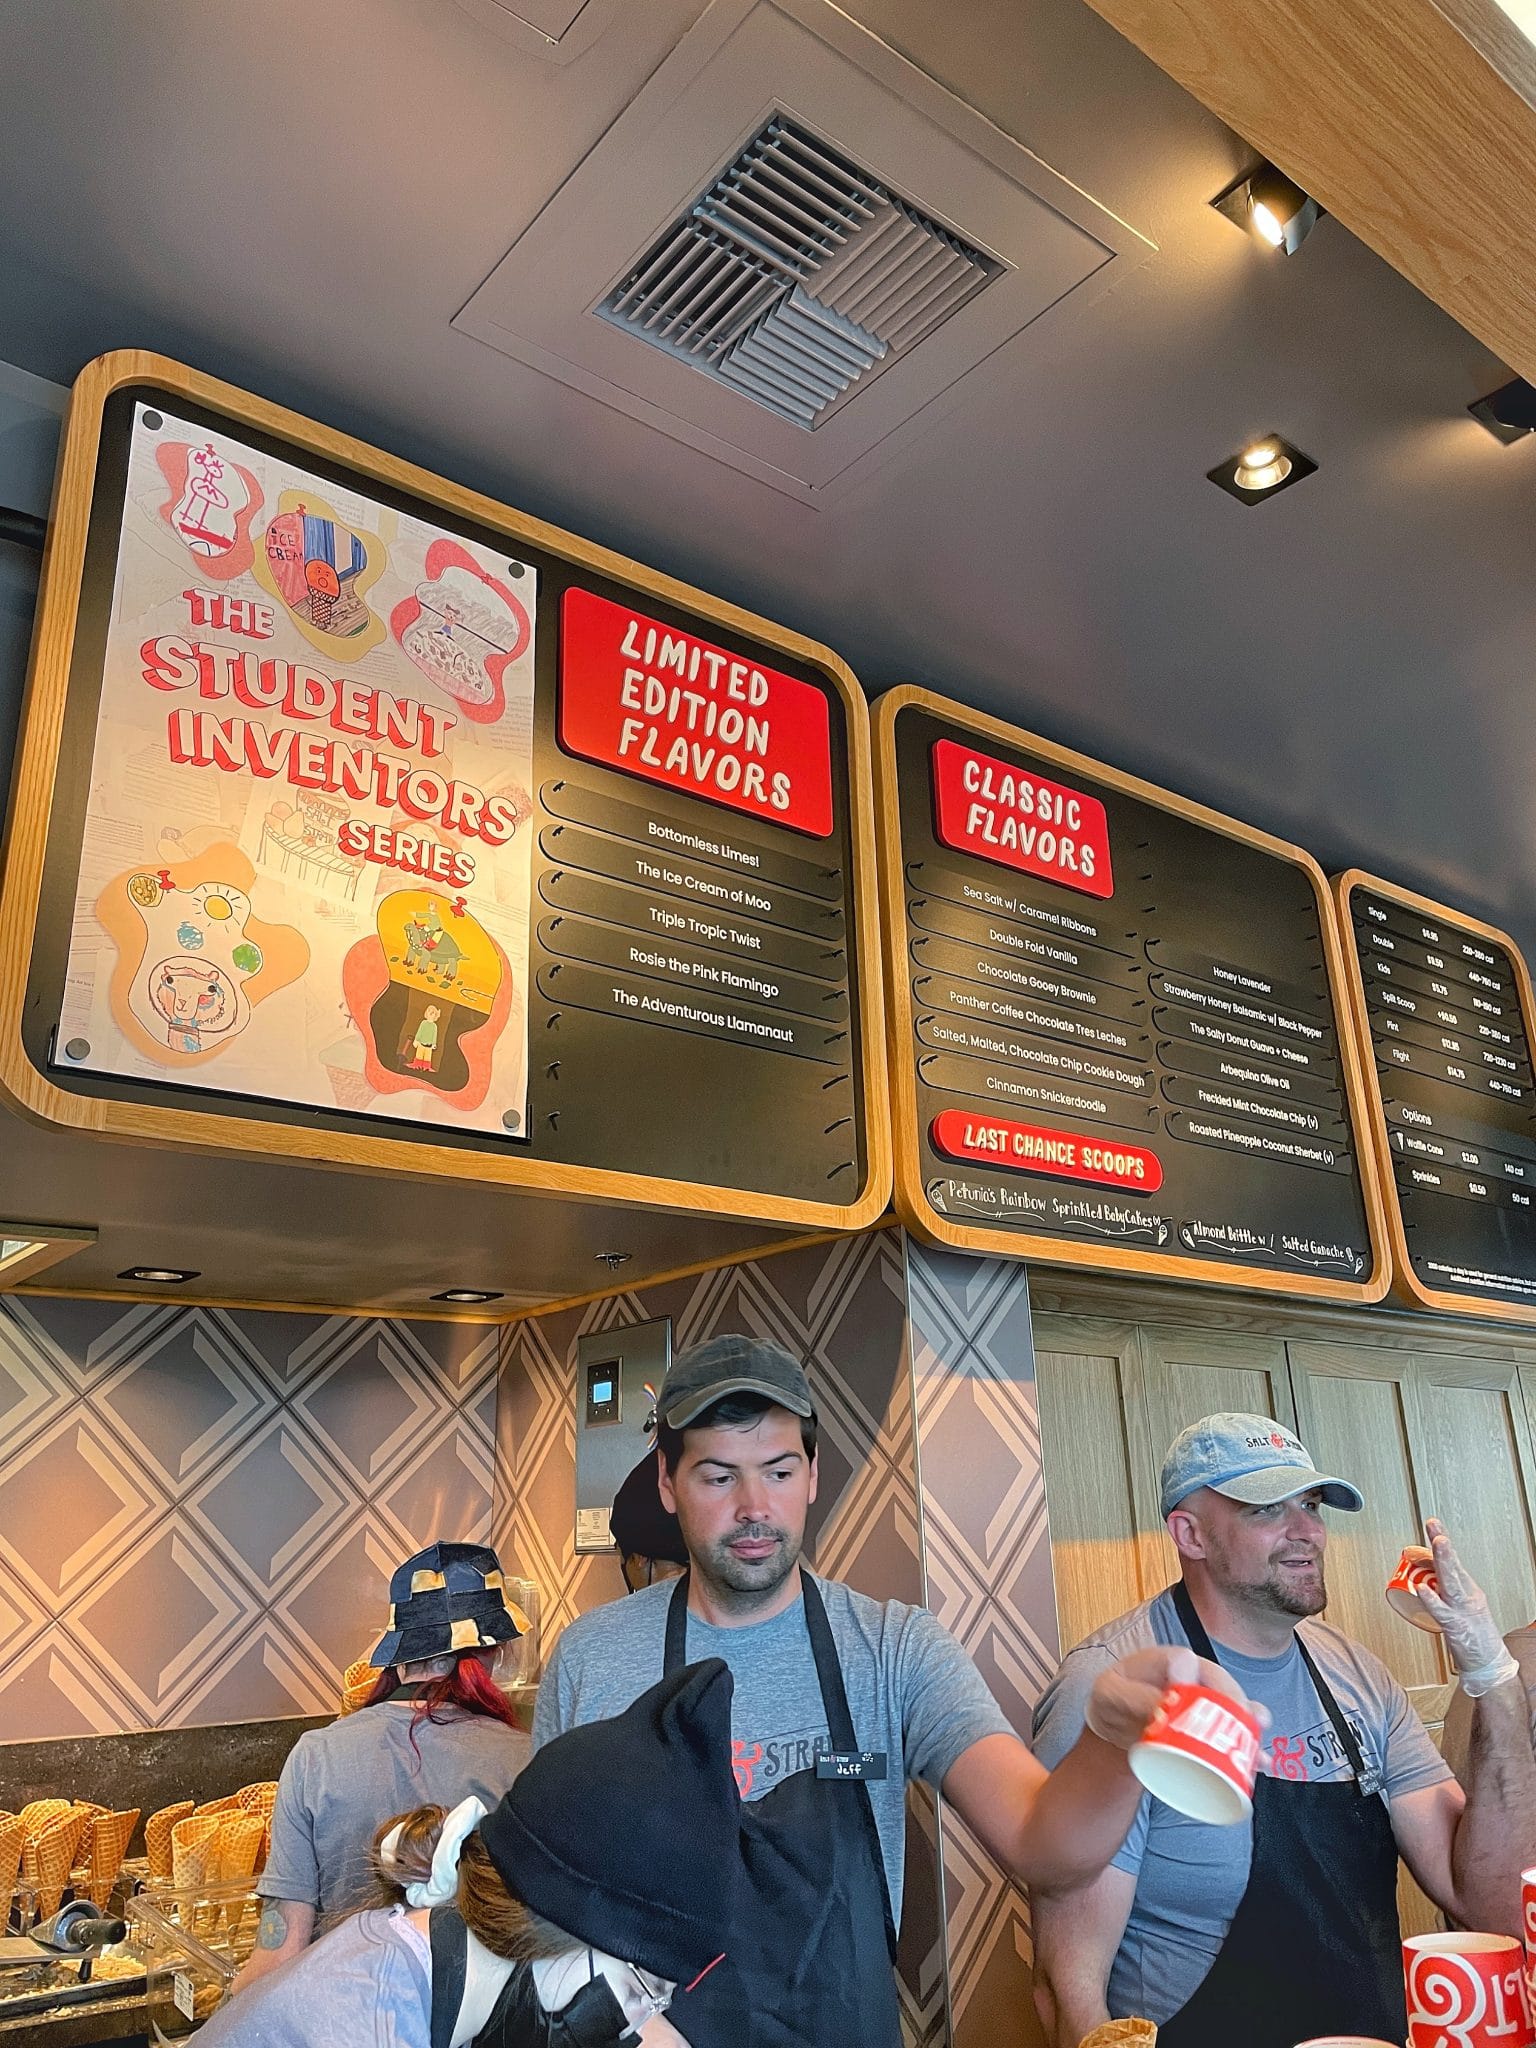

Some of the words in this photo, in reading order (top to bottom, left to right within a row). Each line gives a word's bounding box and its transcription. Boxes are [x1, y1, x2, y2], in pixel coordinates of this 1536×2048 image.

[183, 587, 275, 640] THE
[620, 620, 768, 706] LIMITED
[141, 634, 458, 762] STUDENT
[620, 667, 768, 756] EDITION
[168, 708, 518, 847] INVENTORS
[617, 717, 791, 810] FLAVORS
[963, 760, 1081, 831] CLASSIC
[338, 819, 476, 888] SERIES
[648, 822, 719, 855] Bottomless
[721, 844, 760, 868] Limes!
[966, 803, 1095, 877] FLAVORS
[636, 861, 660, 878] The
[663, 868, 682, 885] Ice
[685, 875, 728, 899] Cream
[731, 889, 743, 903] of
[745, 893, 771, 911] Moo
[649, 907, 685, 929] Triple
[688, 918, 727, 940] Tropic
[729, 930, 760, 950] Twist
[963, 885, 982, 901] Sea
[984, 890, 1004, 908] Salt
[1005, 898, 1017, 913] w/
[1019, 903, 1060, 924] Caramel
[1061, 914, 1097, 937] Ribbons
[1368, 907, 1387, 922] Single
[989, 929, 1023, 949] Double
[1025, 939, 1045, 956] Fold
[1047, 946, 1078, 965] Vanilla
[1372, 934, 1395, 950] Double
[630, 947, 666, 967] Rosie
[668, 957, 690, 974] the
[692, 963, 719, 982] Pink
[721, 971, 779, 998] Flamingo
[977, 961, 1027, 986] Chocolate
[1029, 975, 1059, 996] Gooey
[1061, 984, 1096, 1004] Brownie
[1213, 966, 1237, 985] Honey
[1238, 975, 1271, 994] Lavender
[1377, 962, 1391, 975] Kids
[612, 988, 638, 1006] The
[641, 996, 724, 1027] Adventurous
[727, 1015, 793, 1042] Llamanaut
[950, 991, 990, 1013] Panther
[991, 1001, 1024, 1020] Coffee
[1025, 1010, 1075, 1034] Chocolate
[1076, 1023, 1095, 1039] Tres
[1096, 1028, 1127, 1047] Leches
[1163, 982, 1207, 1006] Strawberry
[1208, 993, 1232, 1013] Honey
[1233, 1003, 1267, 1022] Balsamic
[1278, 1017, 1297, 1032] Black
[1298, 1023, 1322, 1039] Pepper
[1382, 991, 1396, 1005] Split
[1396, 995, 1416, 1012] Scoop
[1190, 1022, 1205, 1036] The
[1206, 1027, 1225, 1044] Salty
[1226, 1033, 1249, 1048] Donut
[1250, 1040, 1275, 1056] Guava
[1281, 1048, 1309, 1065] Cheese
[1387, 1020, 1399, 1033] Pint
[933, 1026, 969, 1046] Salted,
[970, 1034, 1008, 1056] Malted,
[1009, 1045, 1059, 1067] Chocolate
[1060, 1056, 1083, 1073] Chip
[1083, 1061, 1114, 1079] Cookie
[1115, 1067, 1145, 1088] Dough
[1220, 1063, 1260, 1082] Arbequina
[1261, 1071, 1279, 1088] Olive
[1280, 1078, 1290, 1090] Oil
[1392, 1049, 1410, 1063] Flight
[987, 1077, 1039, 1101] Cinnamon
[1040, 1087, 1107, 1113] Snickerdoodle
[1199, 1089, 1232, 1109] Freckled
[1232, 1098, 1249, 1112] Mint
[1250, 1102, 1288, 1122] Chocolate
[1289, 1112, 1307, 1128] Chip
[1402, 1108, 1432, 1126] Options
[963, 1124, 1009, 1151] LAST
[1013, 1133, 1076, 1166] CHANCE
[1082, 1147, 1145, 1180] SCOOPS
[1189, 1122, 1222, 1140] Roasted
[1223, 1129, 1262, 1149] Pineapple
[1262, 1138, 1294, 1155] Coconut
[1295, 1144, 1323, 1162] Sherbet
[1406, 1138, 1427, 1153] Waffle
[1427, 1143, 1444, 1156] Cone
[1461, 1151, 1479, 1165] $2.00
[1411, 1169, 1441, 1185] Sprinkles
[949, 1180, 996, 1204] Petunia's
[1000, 1187, 1046, 1211] Rainbow
[1052, 1198, 1102, 1219] Sprinkled
[1194, 1221, 1226, 1240] Almond
[1228, 1226, 1257, 1244] Brittle
[1282, 1235, 1309, 1251] Salted
[1310, 1241, 1345, 1259] Ganache
[1245, 1437, 1270, 1449] SALT
[764, 1735, 833, 1777] STRA
[1307, 1718, 1365, 1768] STRW
